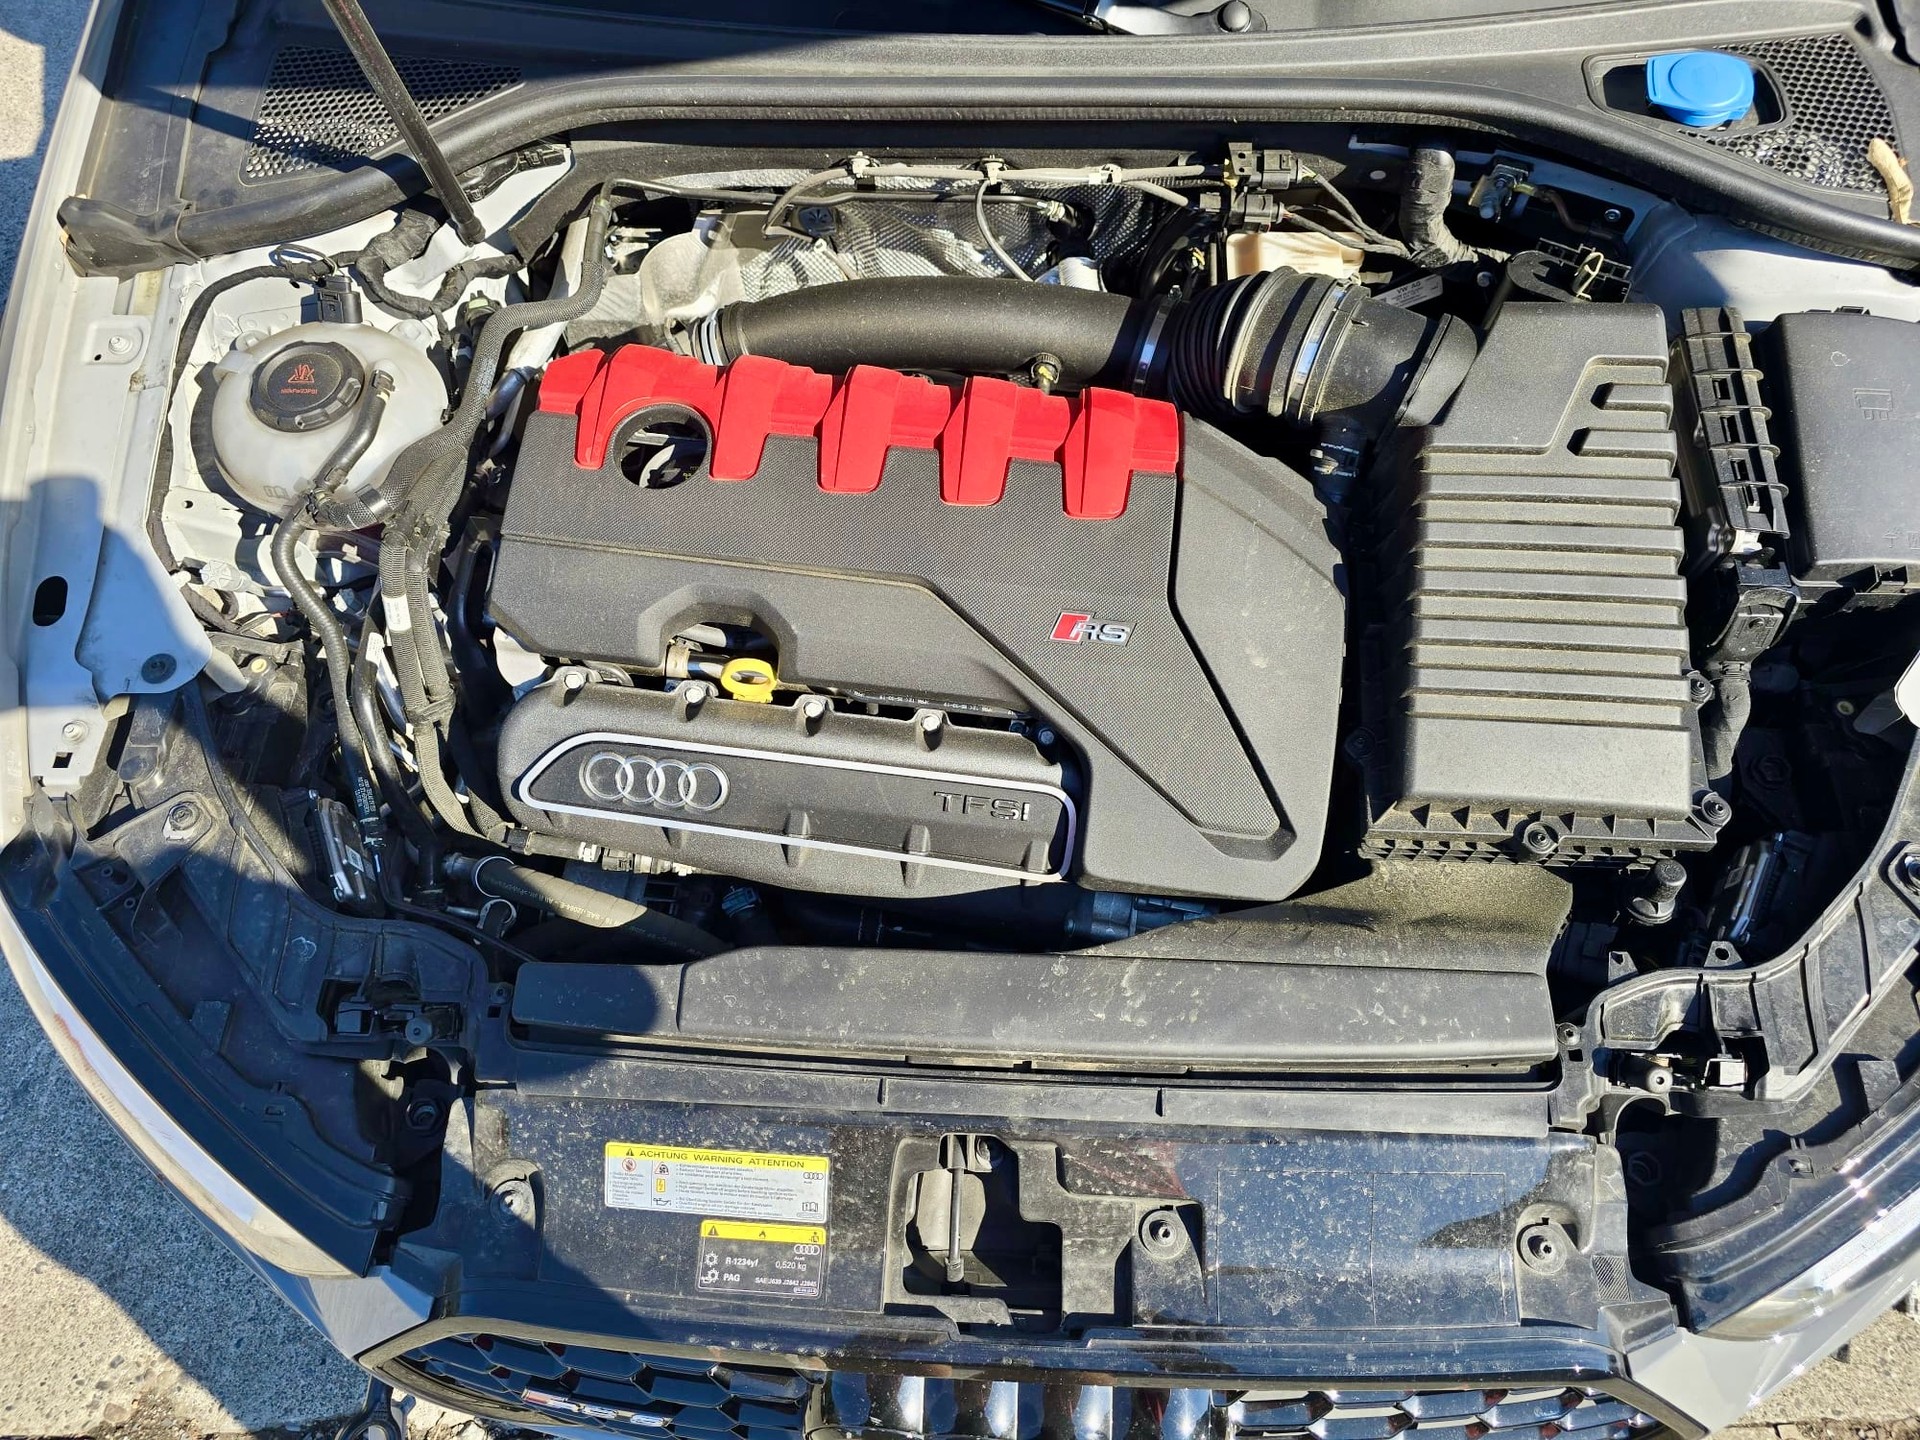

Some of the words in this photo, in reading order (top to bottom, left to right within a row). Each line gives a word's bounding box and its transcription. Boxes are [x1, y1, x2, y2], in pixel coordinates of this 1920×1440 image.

[1067, 620, 1131, 642] RS
[933, 791, 1030, 822] TFSI
[639, 1150, 688, 1161] ACHTUNG
[694, 1154, 743, 1165] WARNING
[749, 1158, 805, 1168] ATTENTION
[725, 1257, 759, 1268] R-1234yf
[775, 1260, 796, 1270] 0,520
[798, 1262, 807, 1271] kg
[723, 1273, 741, 1282] PAG
